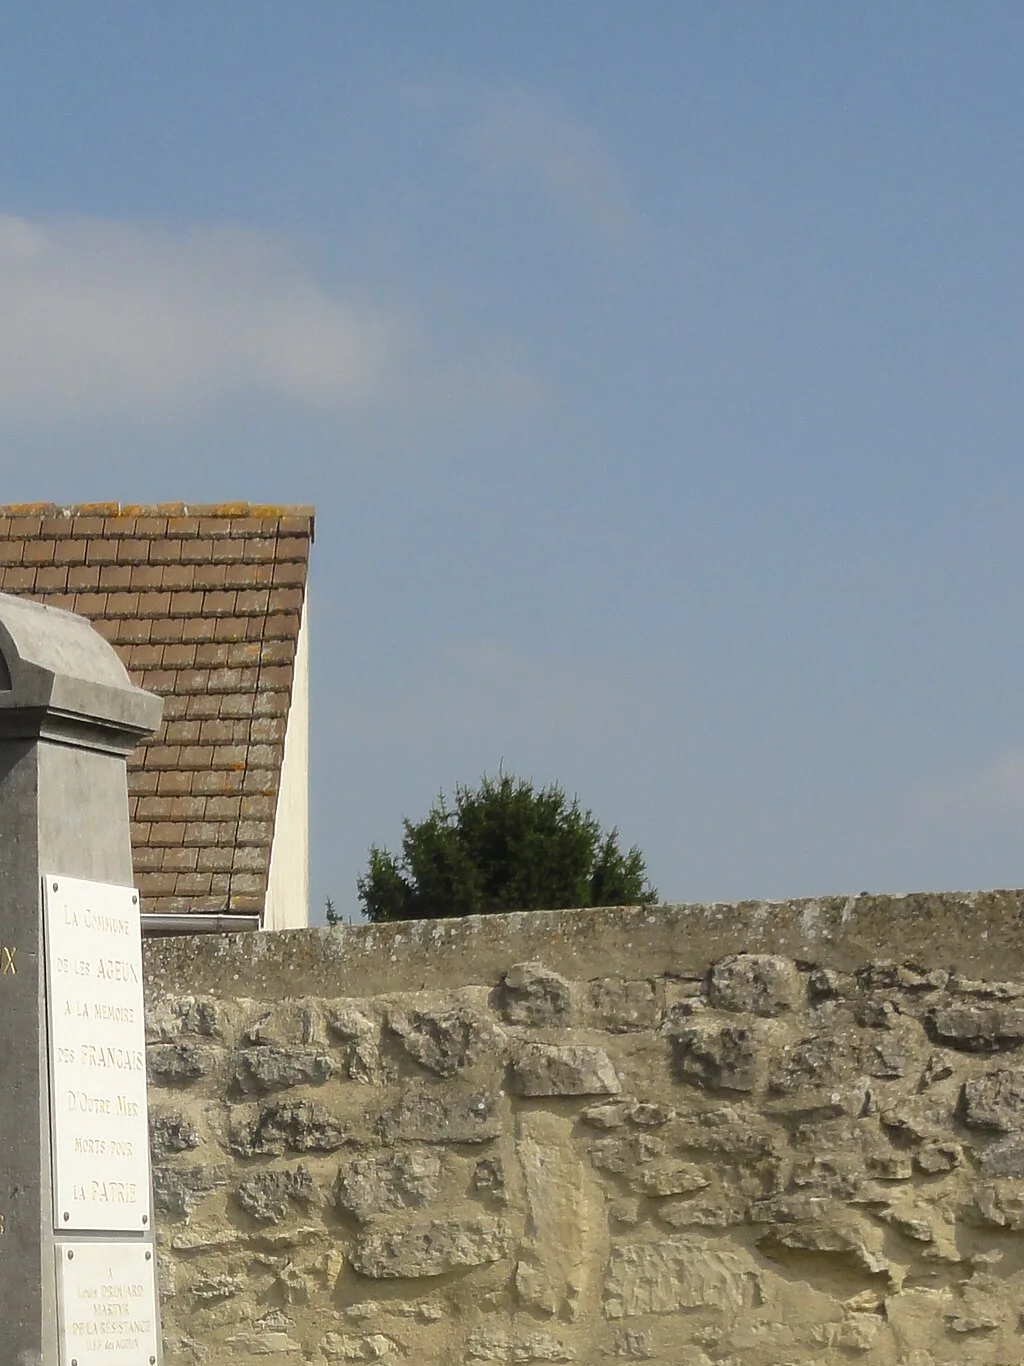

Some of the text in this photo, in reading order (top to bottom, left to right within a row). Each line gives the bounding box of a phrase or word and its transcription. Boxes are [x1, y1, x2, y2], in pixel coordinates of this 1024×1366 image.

[57, 957, 139, 984] DE LES AGEUX
[77, 1002, 89, 1019] LA
[57, 1046, 75, 1064] DES
[73, 1137, 134, 1157] MORTS POUR
[72, 1180, 137, 1204] LA PATRIE
[101, 1284, 144, 1298] DROUARD
[92, 1303, 130, 1317] MARTYR
[72, 1322, 85, 1336] DE
[86, 1322, 99, 1336] LA
